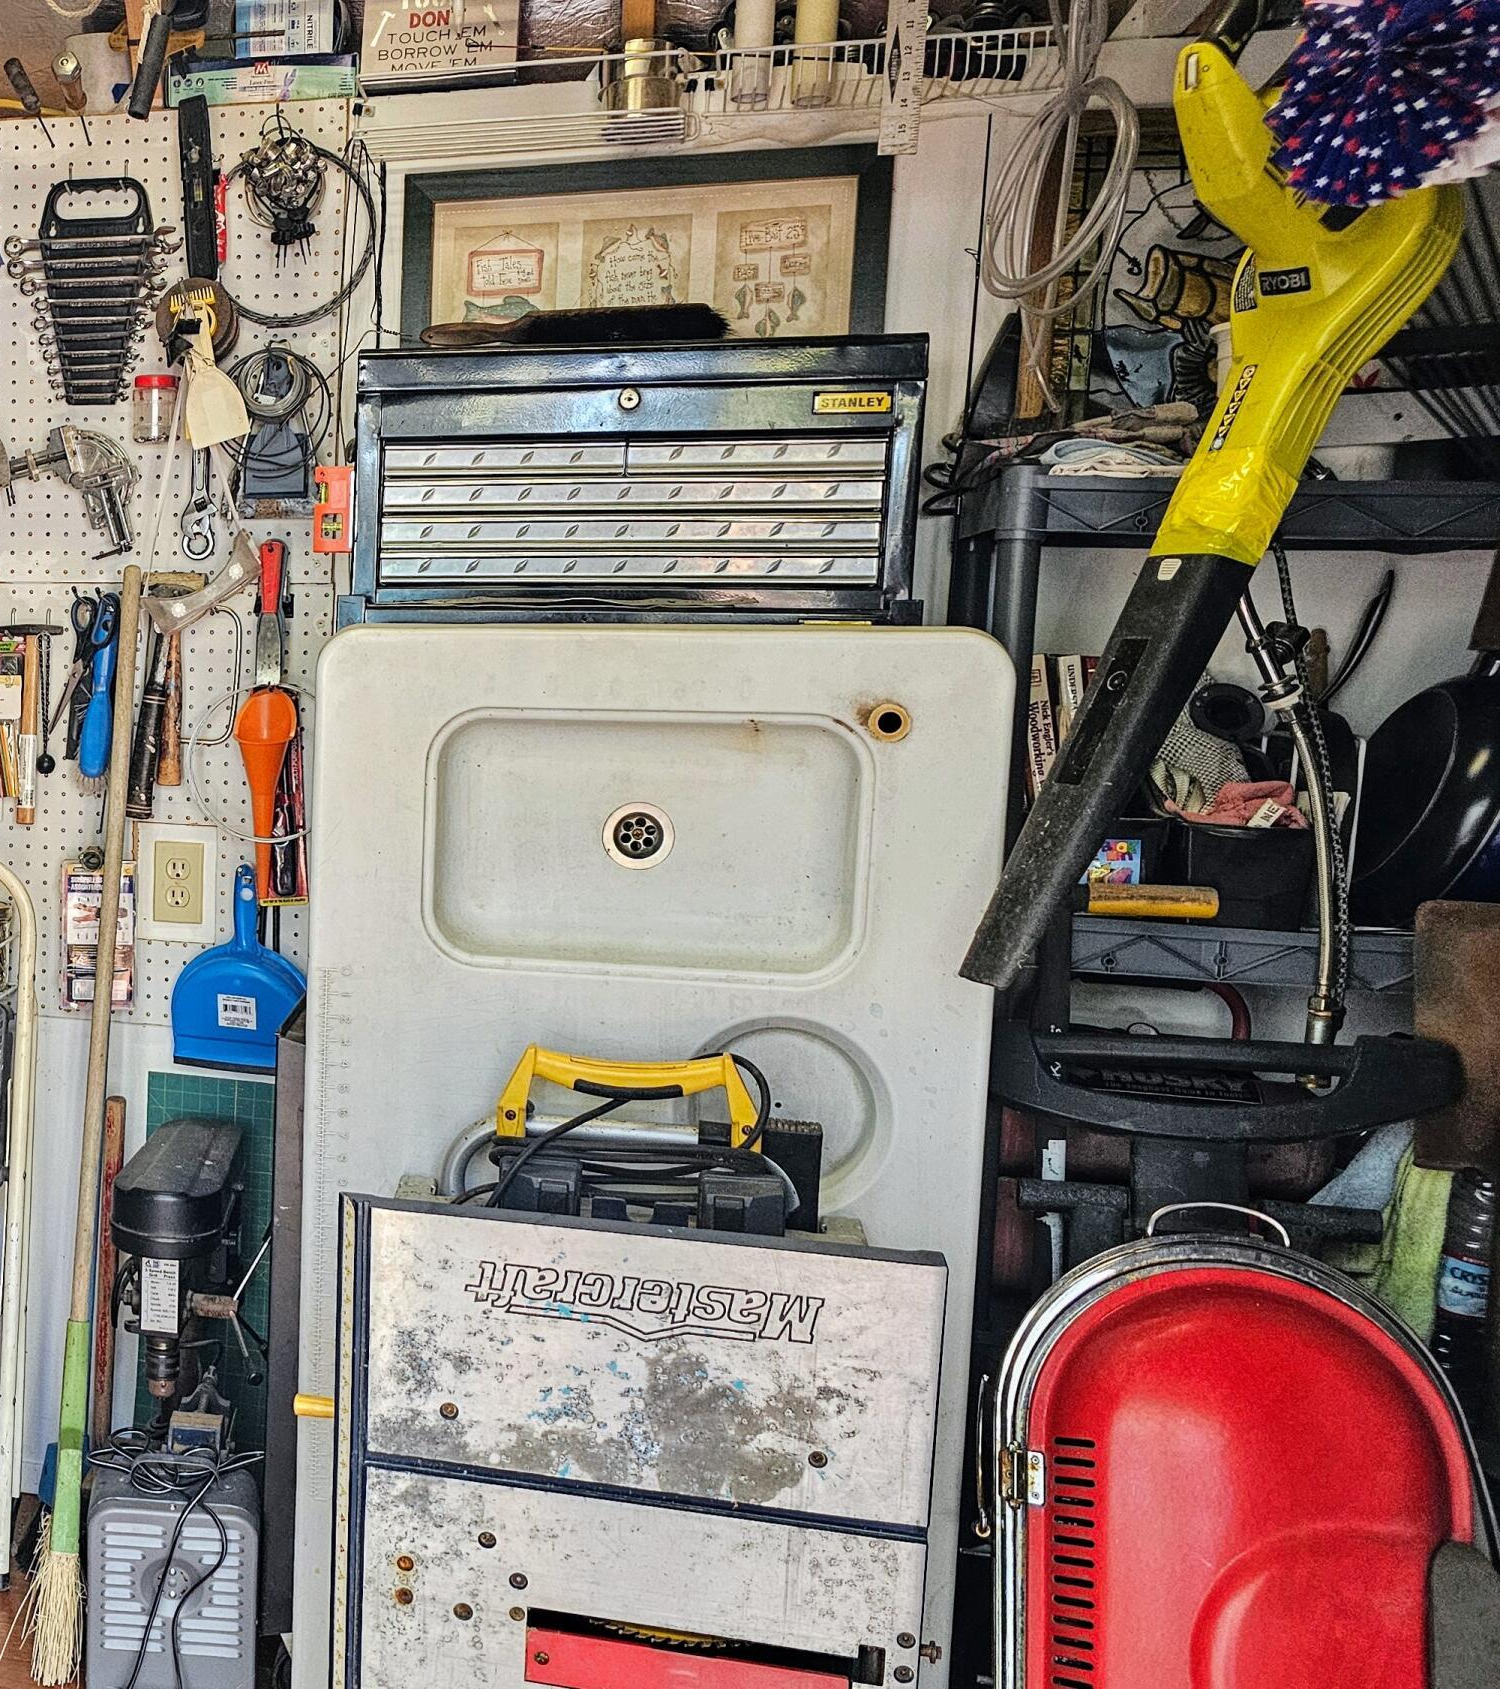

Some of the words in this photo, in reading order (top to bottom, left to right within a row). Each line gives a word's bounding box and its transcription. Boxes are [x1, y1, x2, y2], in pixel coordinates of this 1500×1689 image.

[906, 20, 915, 28] 11
[306, 14, 314, 49] NITRILE
[388, 30, 450, 44] TOUCH
[378, 44, 458, 61] BORROW
[904, 45, 913, 55] 12
[391, 60, 442, 71] MOVE
[902, 71, 911, 81] 13
[900, 98, 908, 108] 14
[898, 123, 907, 133] 15
[476, 259, 493, 275] Fish
[499, 255, 522, 271] Tales
[821, 397, 885, 409] STANLEY
[1040, 701, 1049, 720] Nick
[1029, 701, 1045, 777] Woodworking
[1043, 722, 1053, 756] Engler's
[465, 1260, 825, 1344] Mastercraft
